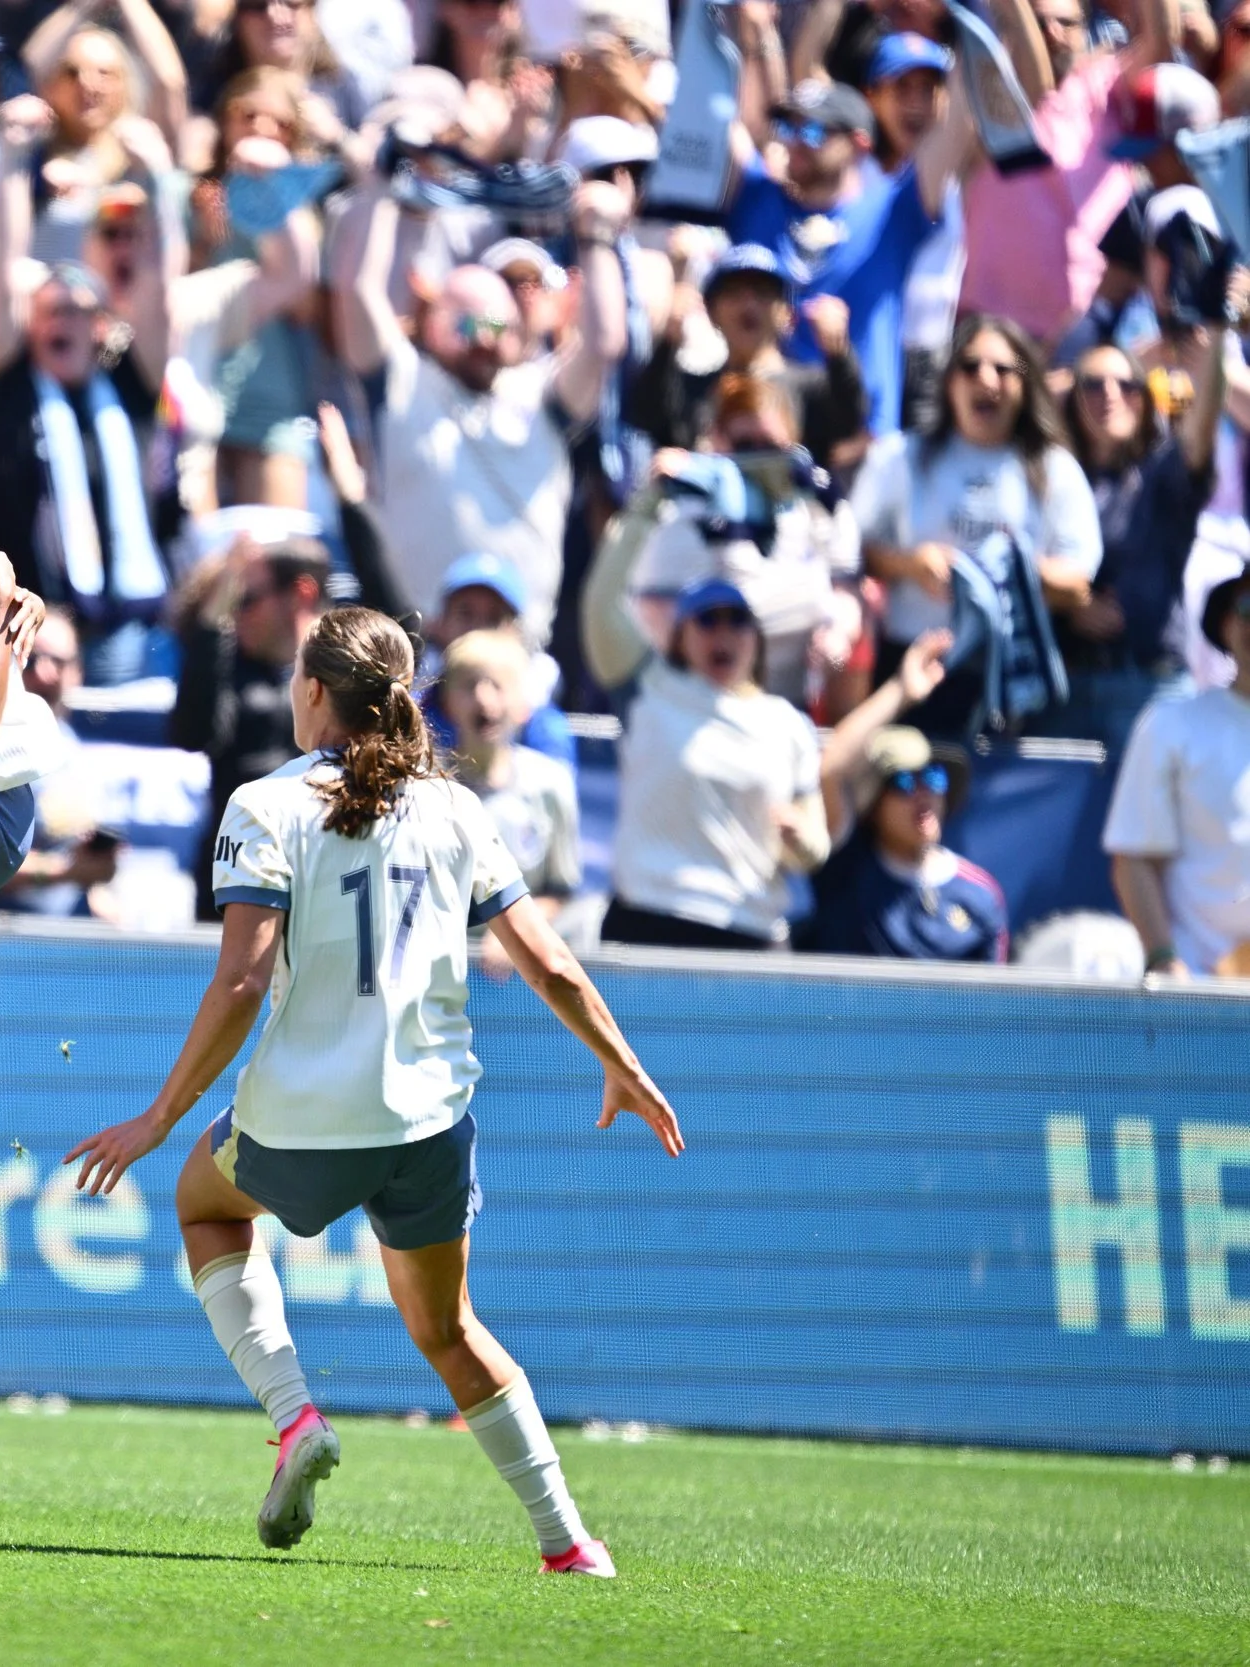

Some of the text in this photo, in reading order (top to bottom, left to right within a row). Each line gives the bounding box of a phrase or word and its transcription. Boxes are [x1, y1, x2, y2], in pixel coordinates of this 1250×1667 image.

[215, 835, 244, 868] lly
[340, 864, 431, 997] 17
[1046, 1112, 1250, 1341] HE
